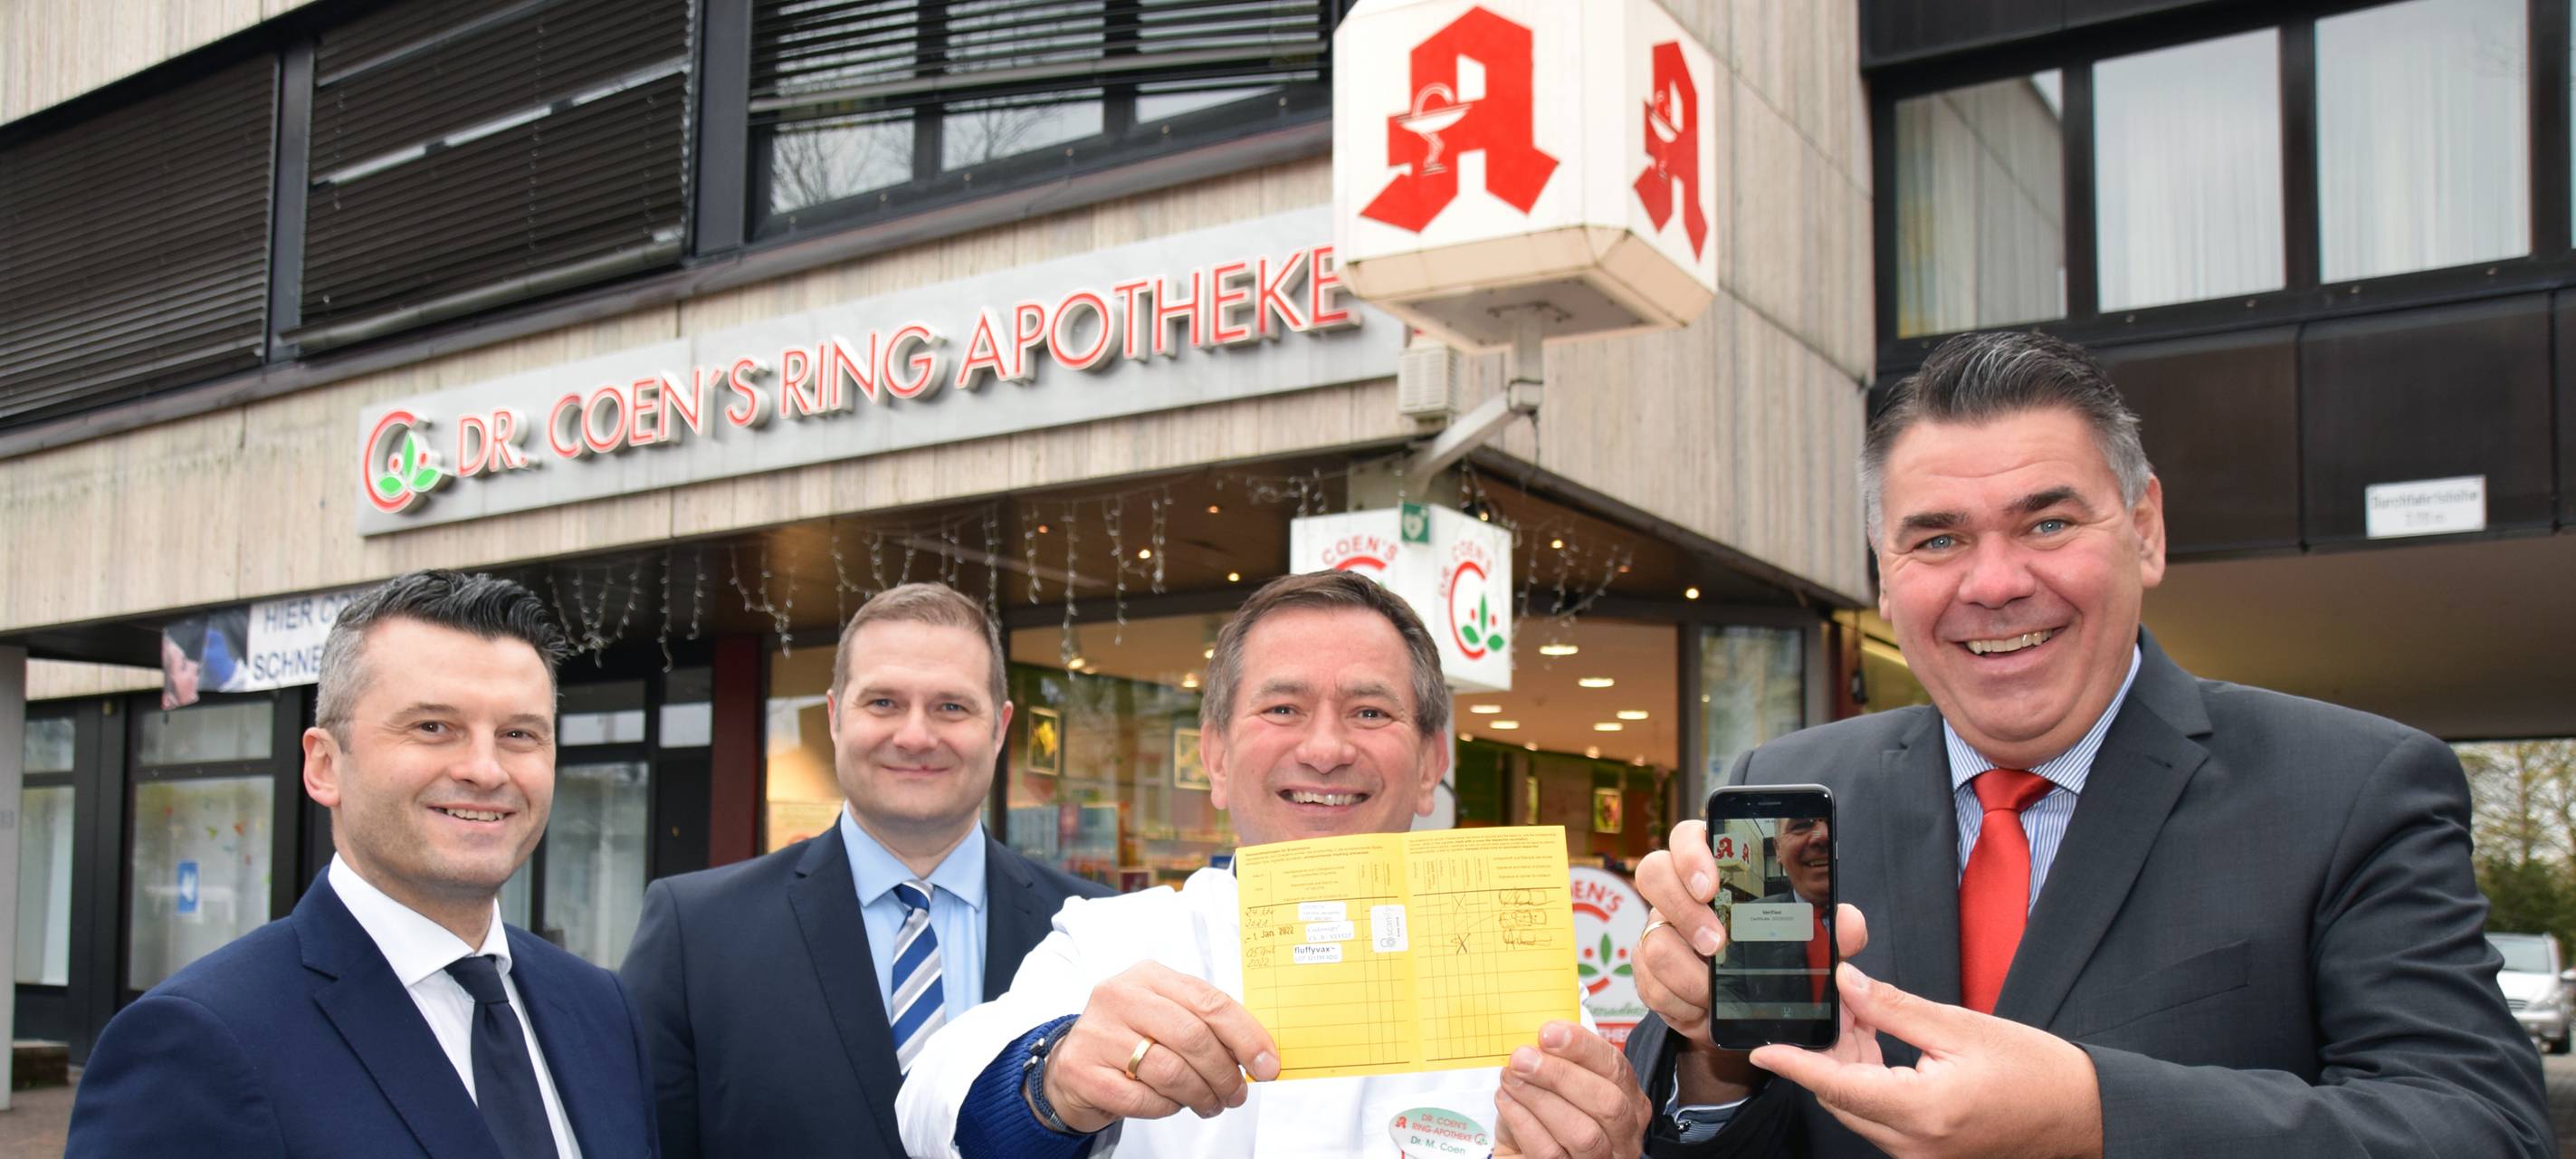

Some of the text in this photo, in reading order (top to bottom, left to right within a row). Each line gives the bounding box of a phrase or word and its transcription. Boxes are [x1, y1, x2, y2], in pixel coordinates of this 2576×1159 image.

[457, 408, 528, 477] DR.
[779, 322, 936, 420] RING
[955, 244, 1350, 390] APOTHEKE
[263, 601, 313, 633] HIER
[253, 645, 320, 681] SCHNE
[1440, 1143, 1466, 1155] Coen
